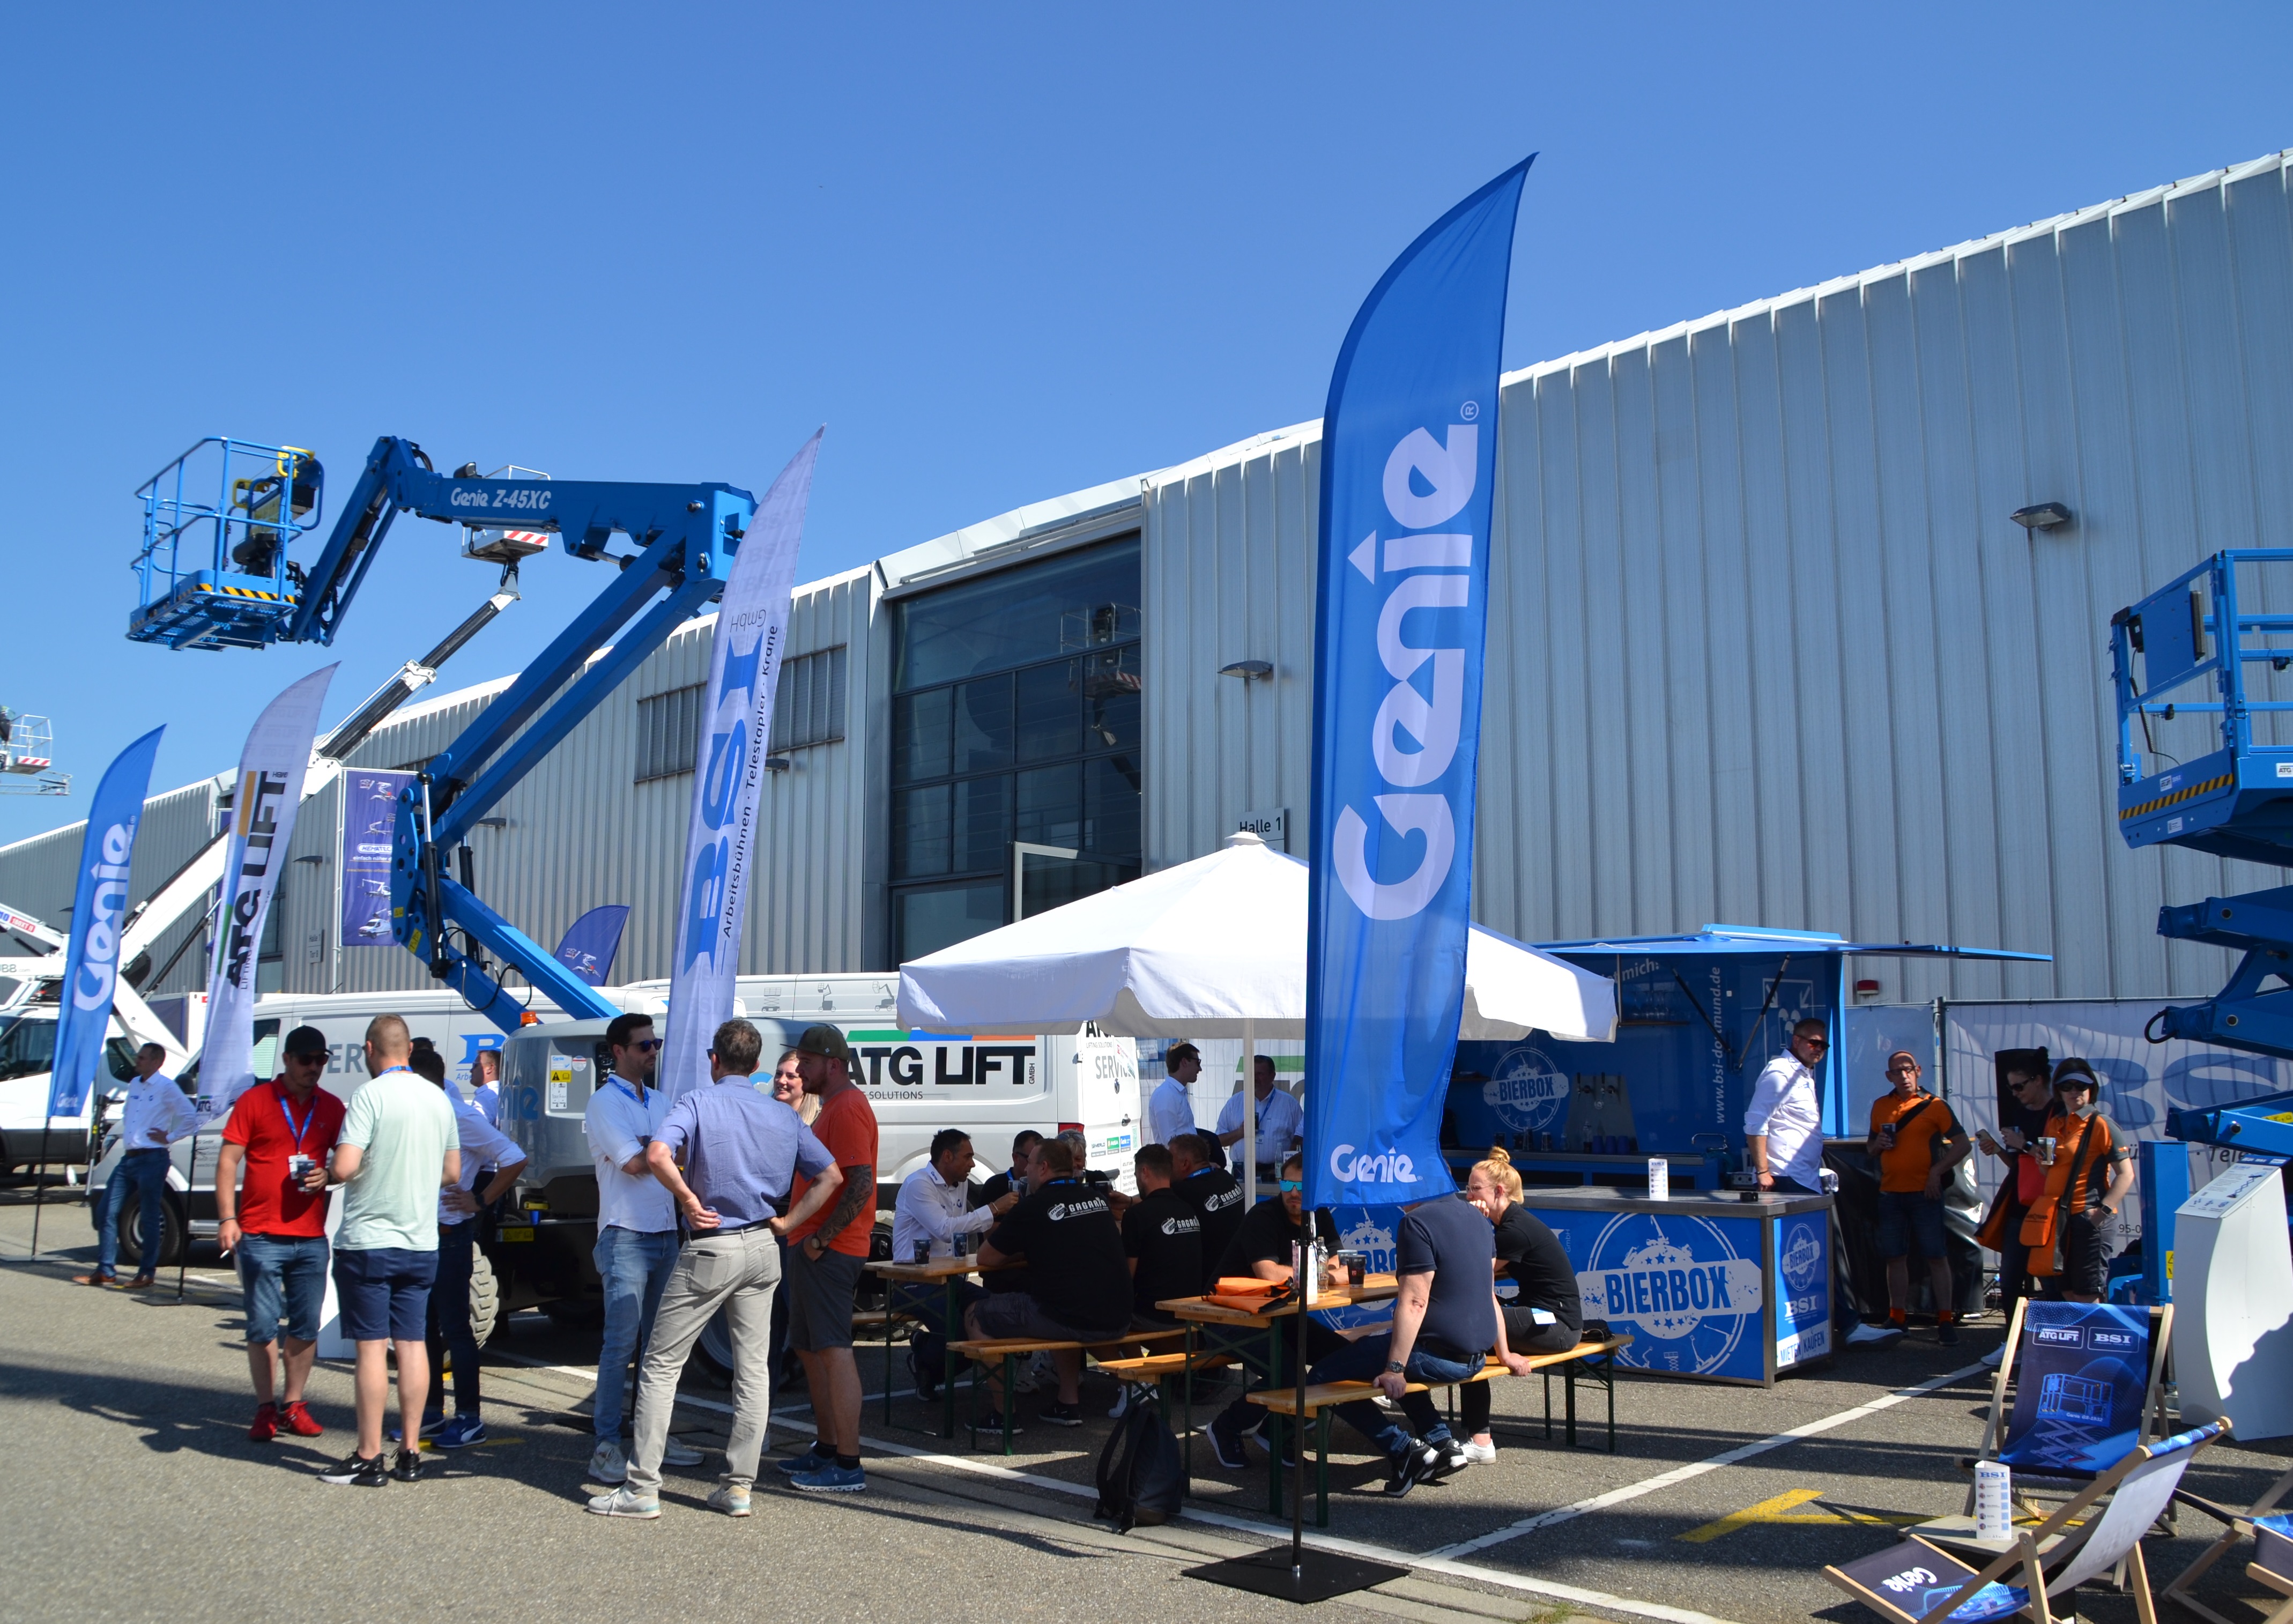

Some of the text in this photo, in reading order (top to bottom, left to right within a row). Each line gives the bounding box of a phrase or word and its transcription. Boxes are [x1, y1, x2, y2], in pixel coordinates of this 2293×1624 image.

[450, 487, 551, 509] Genie Z-45XC
[730, 609, 766, 633] GmbH
[1333, 423, 1478, 921] Genie
[723, 626, 777, 938] Arbeitsbühnen Telestapler Krane
[683, 630, 763, 977] BSI
[242, 771, 286, 877] LIFT
[1240, 817, 1280, 833] Halle 1
[73, 822, 135, 1011] Genie
[1709, 967, 1725, 1123] www.bsi-dotmund.de
[848, 1046, 923, 1086] ATG
[935, 1046, 1035, 1085] LIFT
[498, 1076, 539, 1121] nie
[869, 1091, 923, 1099] SOLUTIONS
[1498, 1077, 1555, 1102] BIERBOX
[1331, 1144, 1418, 1183] Genie
[1789, 1243, 1814, 1269] BIERBOX
[1604, 1266, 1732, 1315] BIERBOX
[1784, 1295, 1817, 1317] BSI
[1780, 1332, 1824, 1363] MIETEN KAUFEN
[2039, 1331, 2079, 1341] ATG LIFT
[2095, 1333, 2131, 1344] BSI
